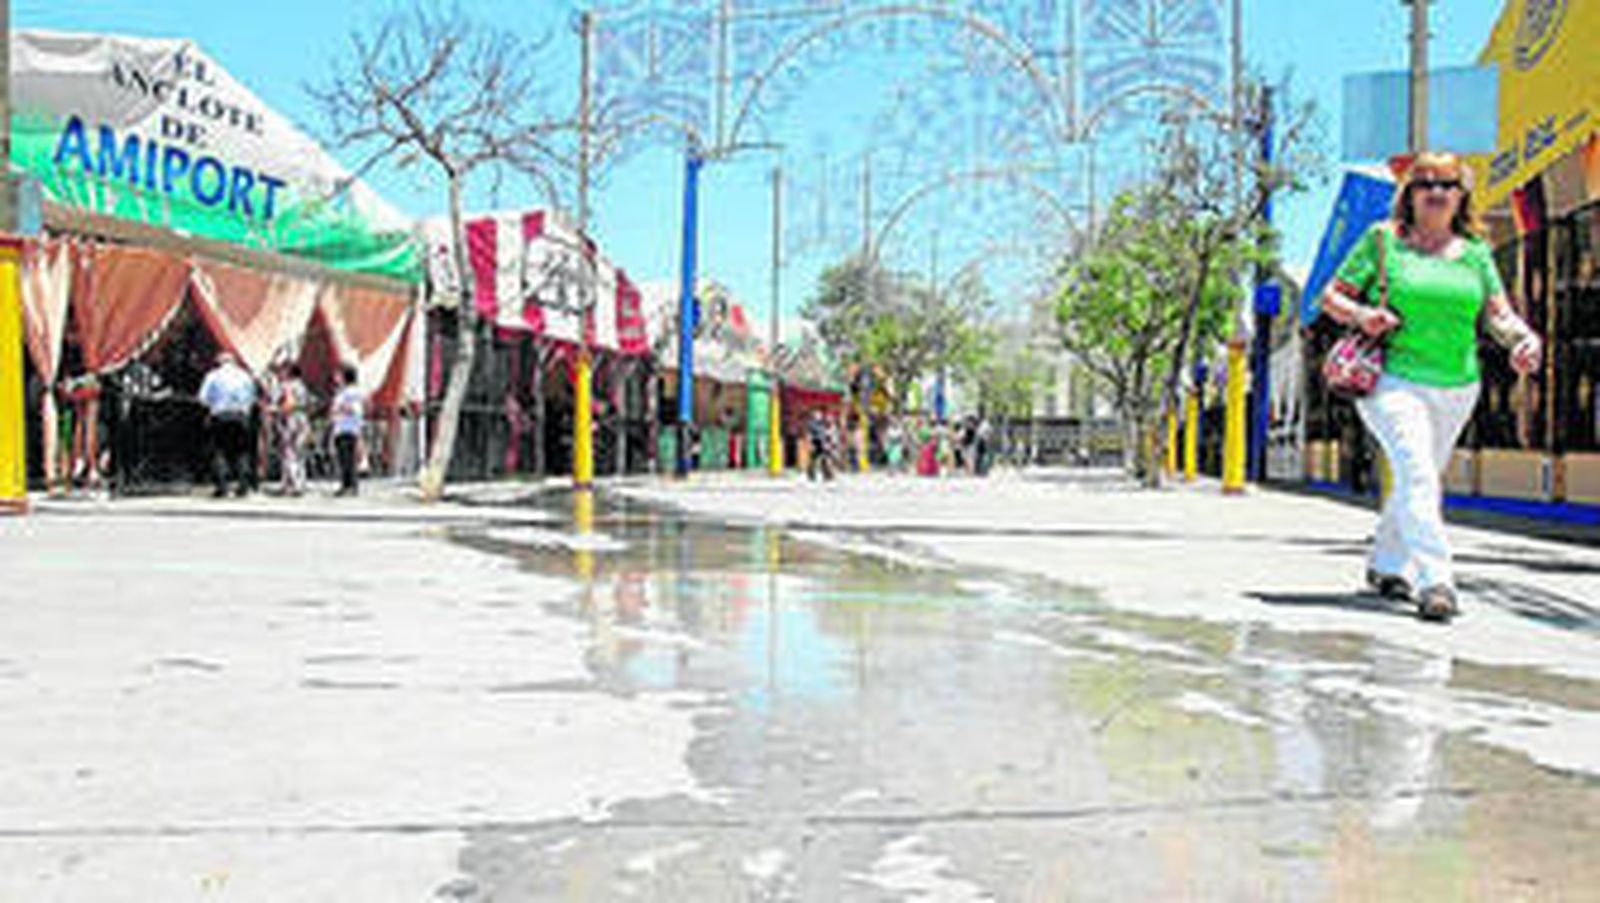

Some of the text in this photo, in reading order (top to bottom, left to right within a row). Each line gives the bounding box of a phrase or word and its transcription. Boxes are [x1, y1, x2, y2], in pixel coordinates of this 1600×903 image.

[174, 48, 215, 86] EL
[109, 63, 265, 136] ANCLOTE
[160, 114, 208, 146] DE
[53, 114, 287, 220] AMIPORT
